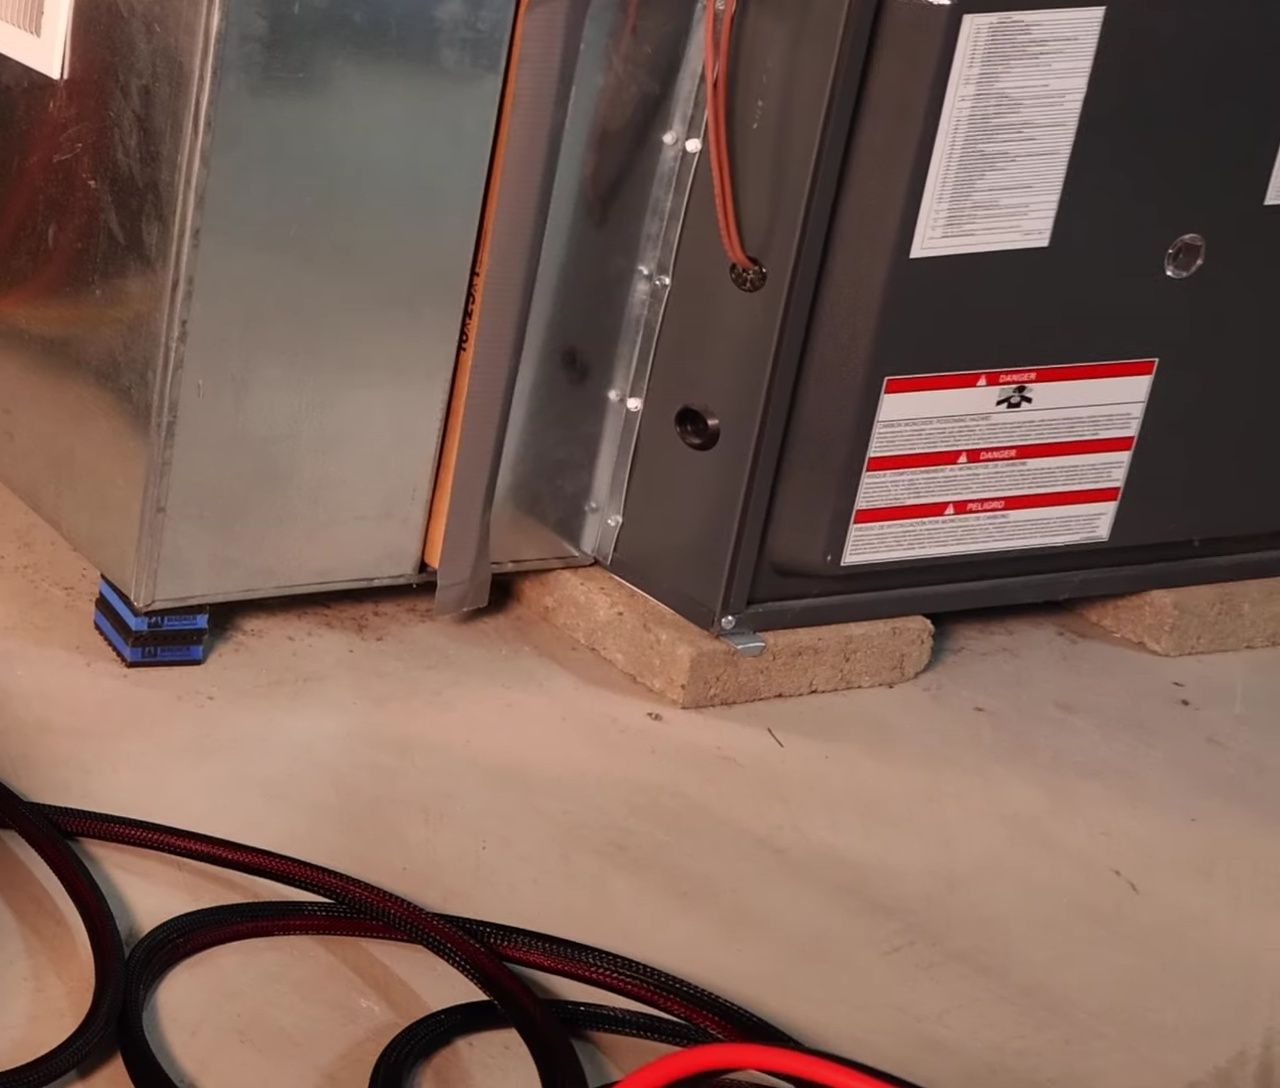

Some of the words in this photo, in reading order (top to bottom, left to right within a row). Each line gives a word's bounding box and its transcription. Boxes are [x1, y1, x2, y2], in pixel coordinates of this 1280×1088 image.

[998, 371, 1037, 384] DANGER
[979, 448, 1017, 460] DANGER
[966, 498, 1005, 511] PELIGRO
